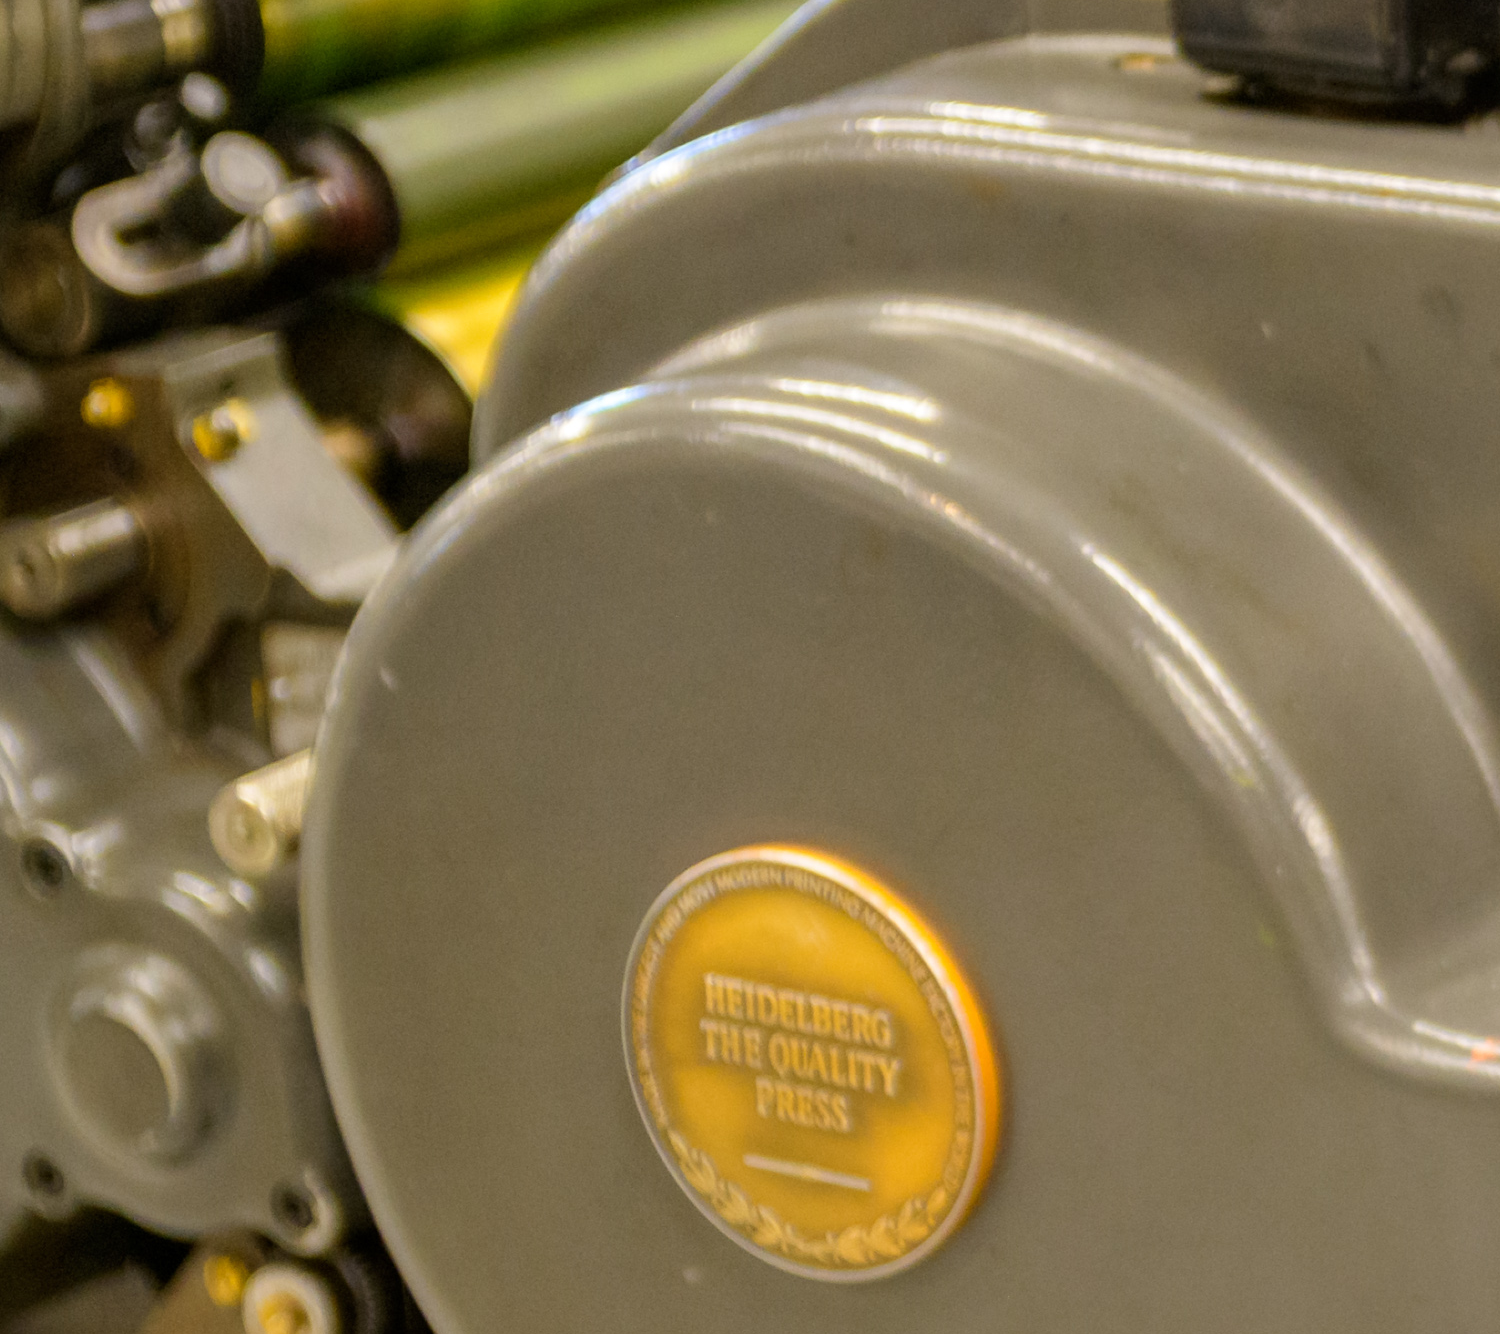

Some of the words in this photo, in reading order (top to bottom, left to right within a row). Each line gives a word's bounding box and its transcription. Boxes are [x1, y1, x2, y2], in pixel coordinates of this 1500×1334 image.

[703, 970, 894, 1048] HEIDELBERG
[700, 1019, 763, 1069] THE
[768, 1033, 902, 1097] QUALITY
[755, 1075, 851, 1133] PRESS
